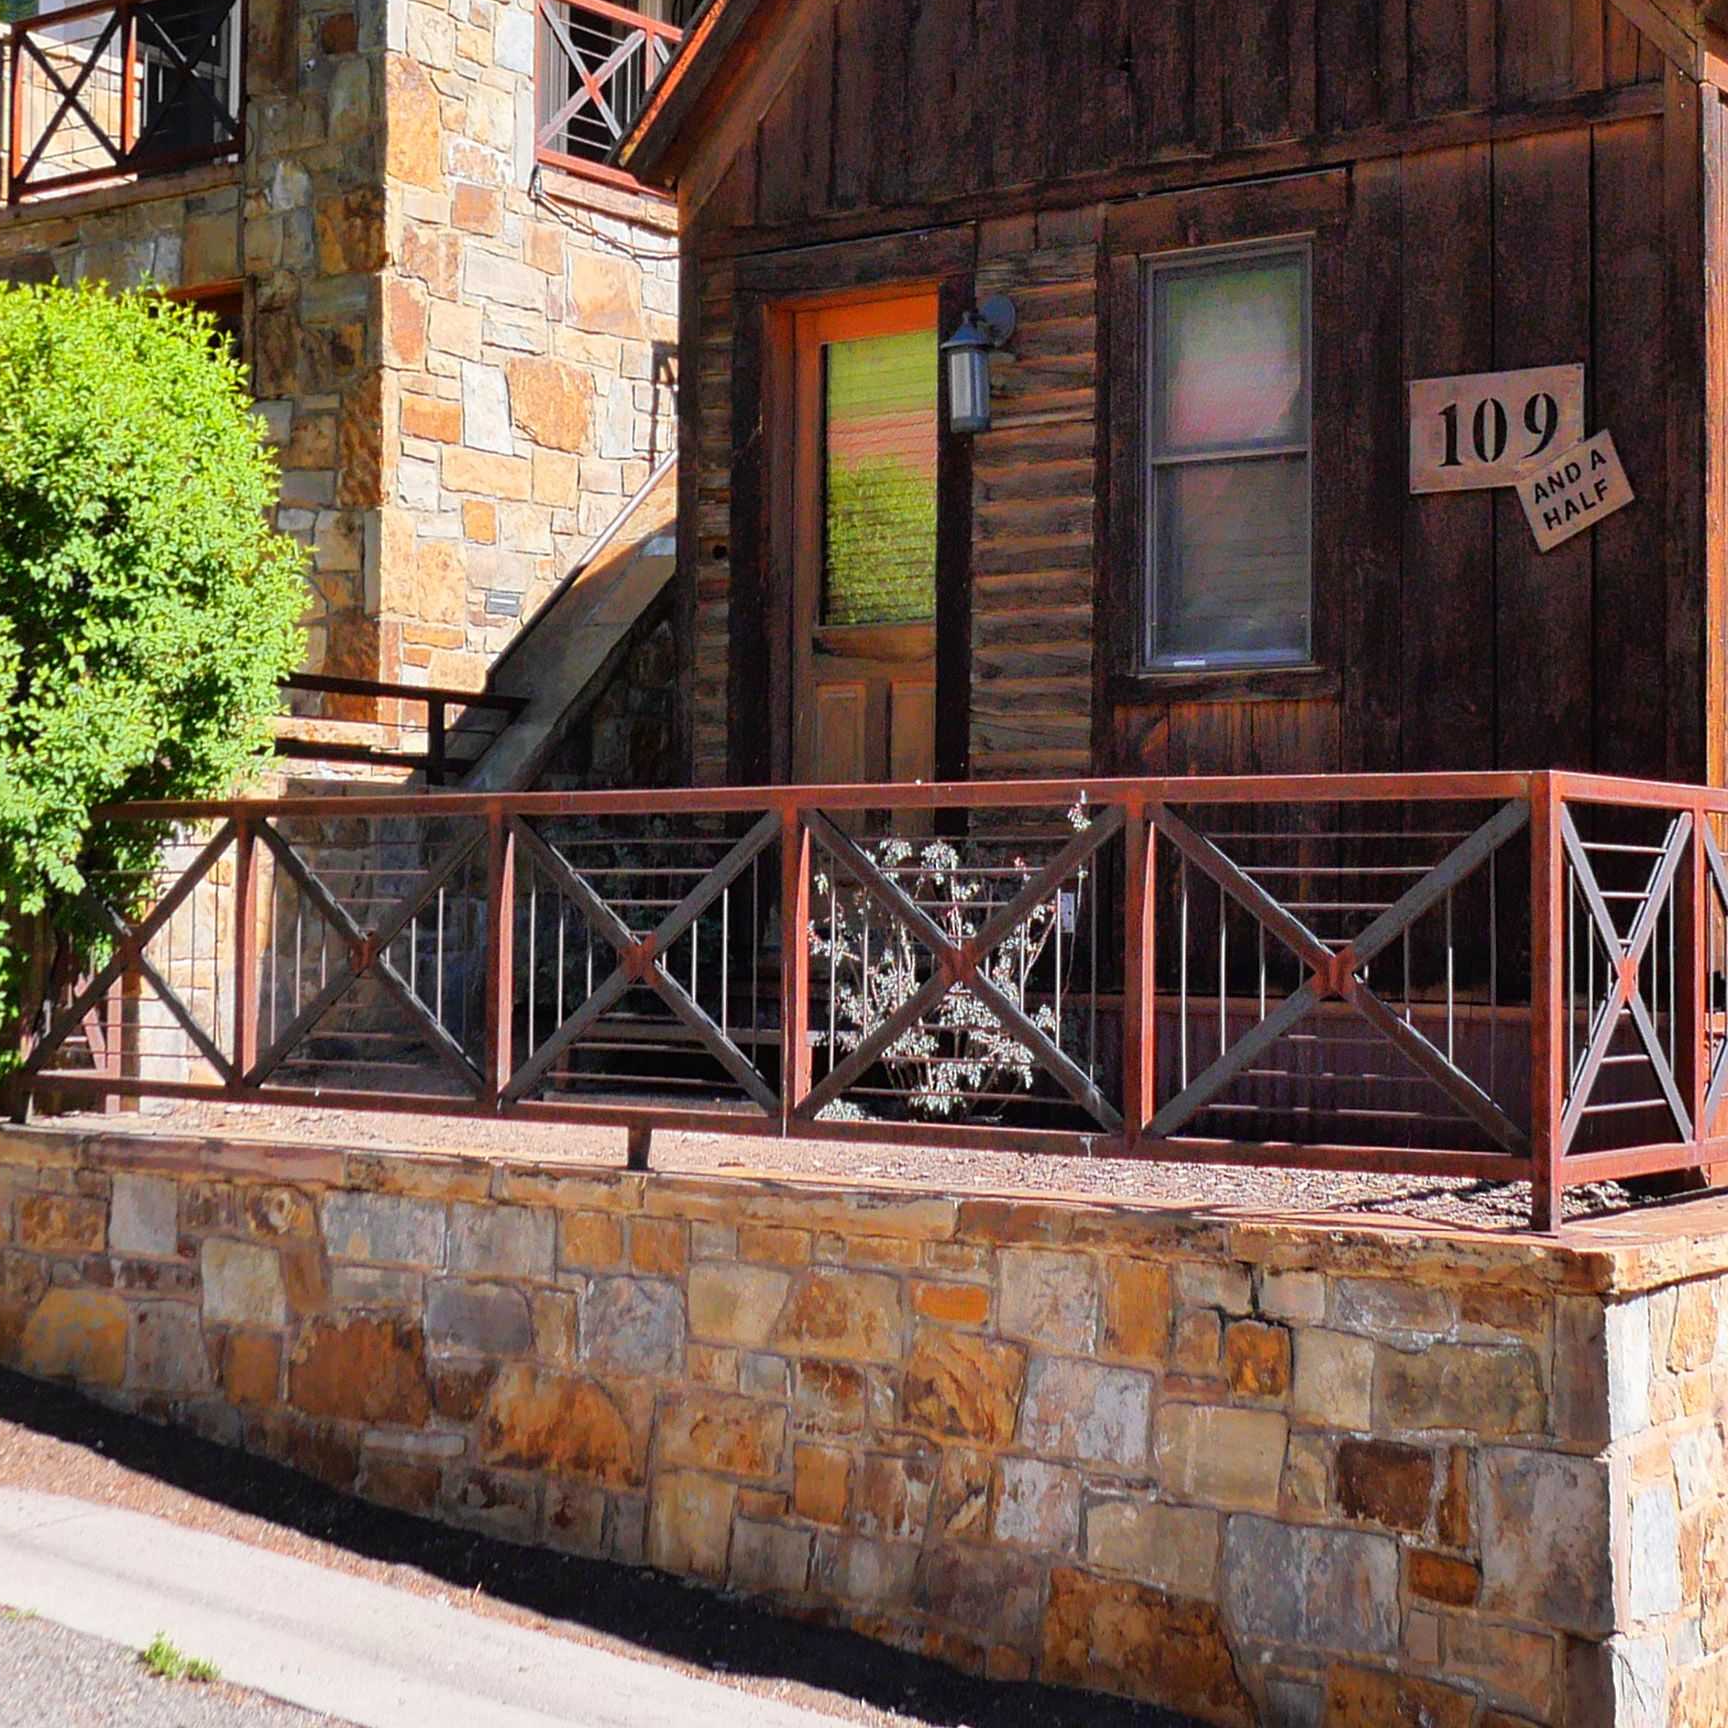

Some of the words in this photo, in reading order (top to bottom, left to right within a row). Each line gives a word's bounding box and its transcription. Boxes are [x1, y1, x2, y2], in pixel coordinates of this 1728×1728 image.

[1437, 392, 1559, 468] 109
[1533, 460, 1582, 505] AND
[1589, 448, 1608, 471] A
[1542, 478, 1609, 531] HALF
